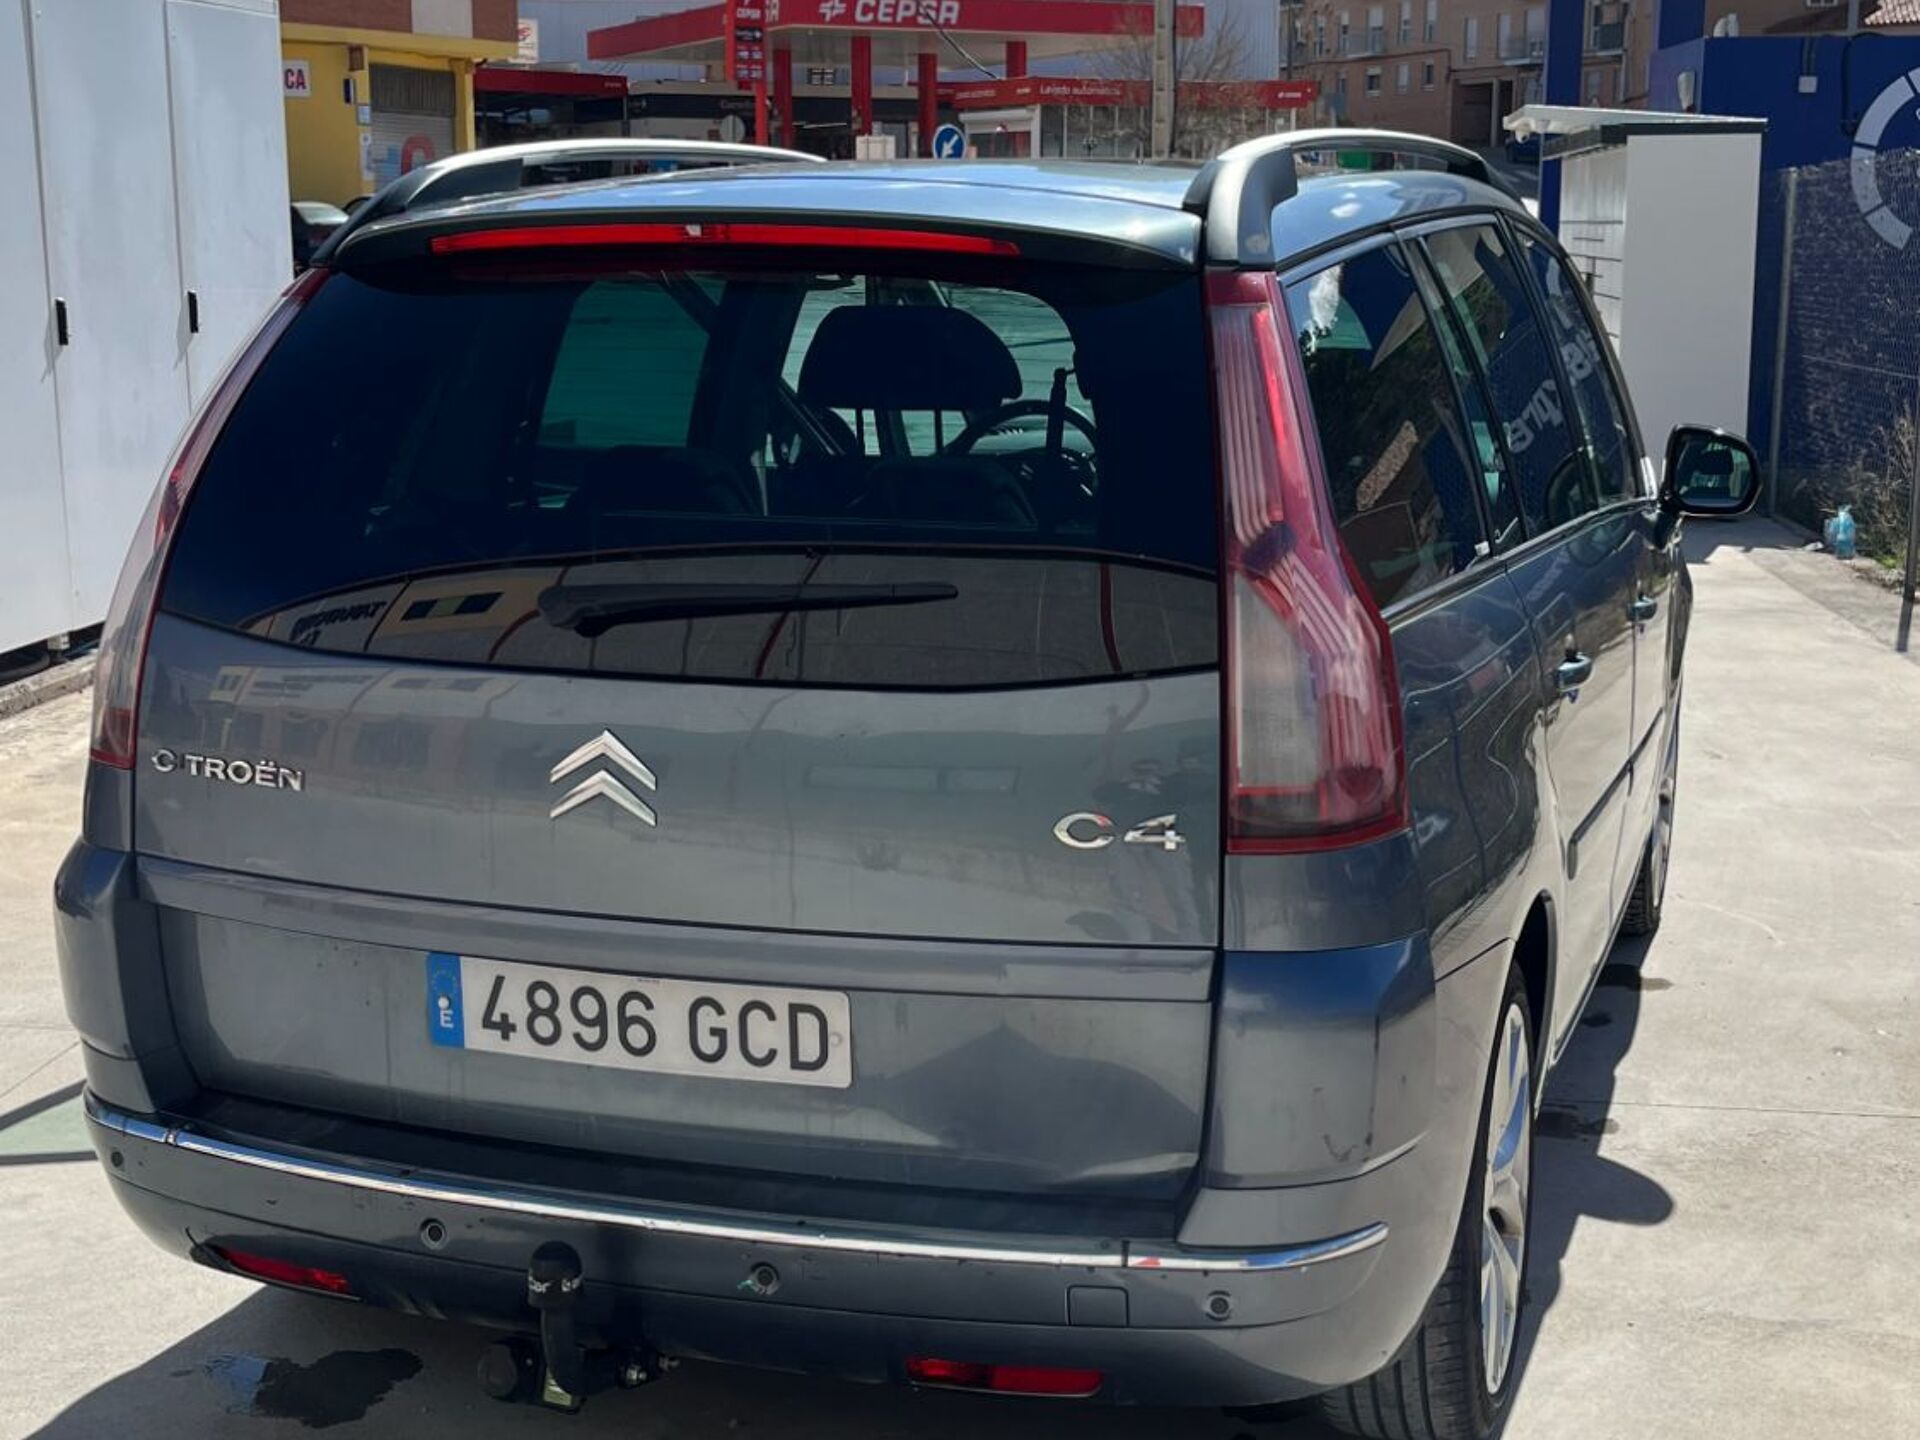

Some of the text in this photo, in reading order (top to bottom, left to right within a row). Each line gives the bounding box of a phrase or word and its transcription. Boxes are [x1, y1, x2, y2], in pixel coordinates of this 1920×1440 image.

[855, 0, 960, 25] CEPSA
[151, 749, 304, 791] CITROËN
[481, 975, 829, 1072] 4896 GCD
